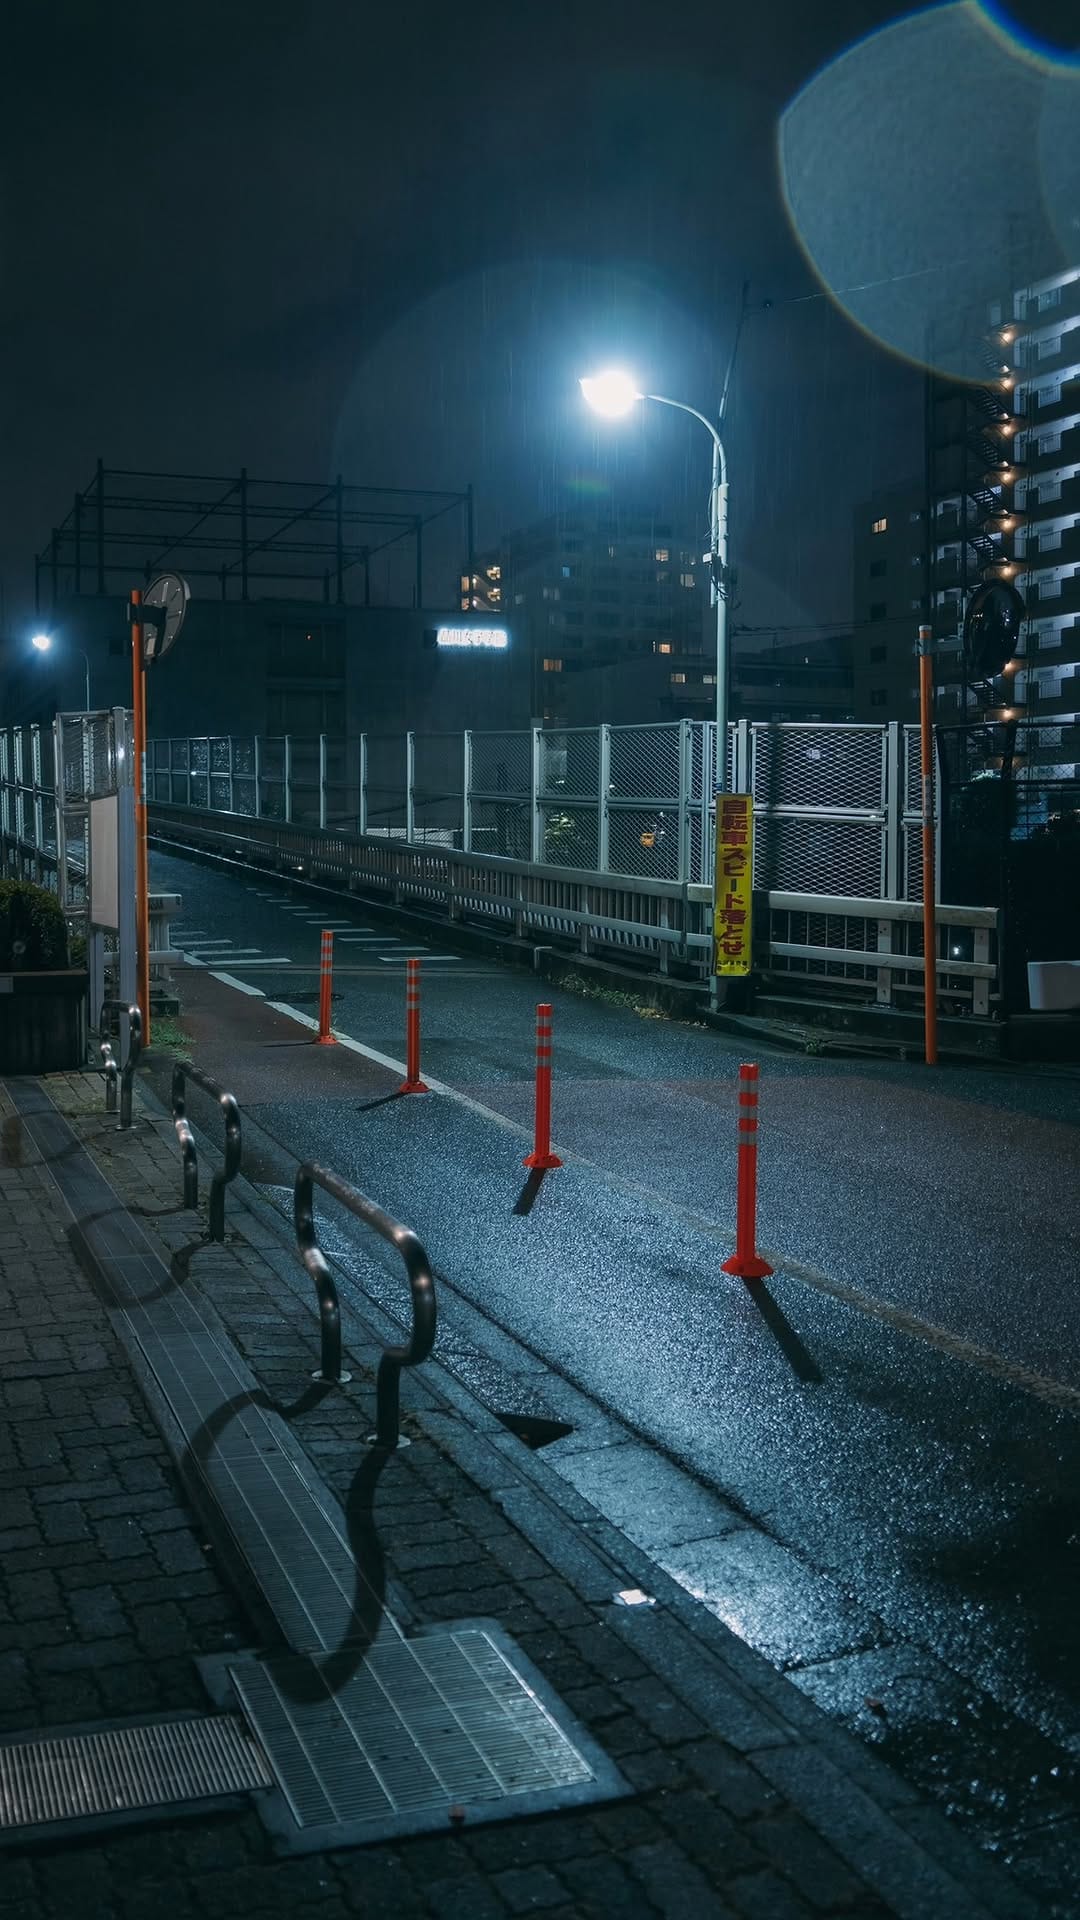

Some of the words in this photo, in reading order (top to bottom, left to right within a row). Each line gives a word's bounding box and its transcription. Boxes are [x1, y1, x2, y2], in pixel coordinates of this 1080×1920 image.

[720, 799, 748, 956] 自転車スピード落とせ
